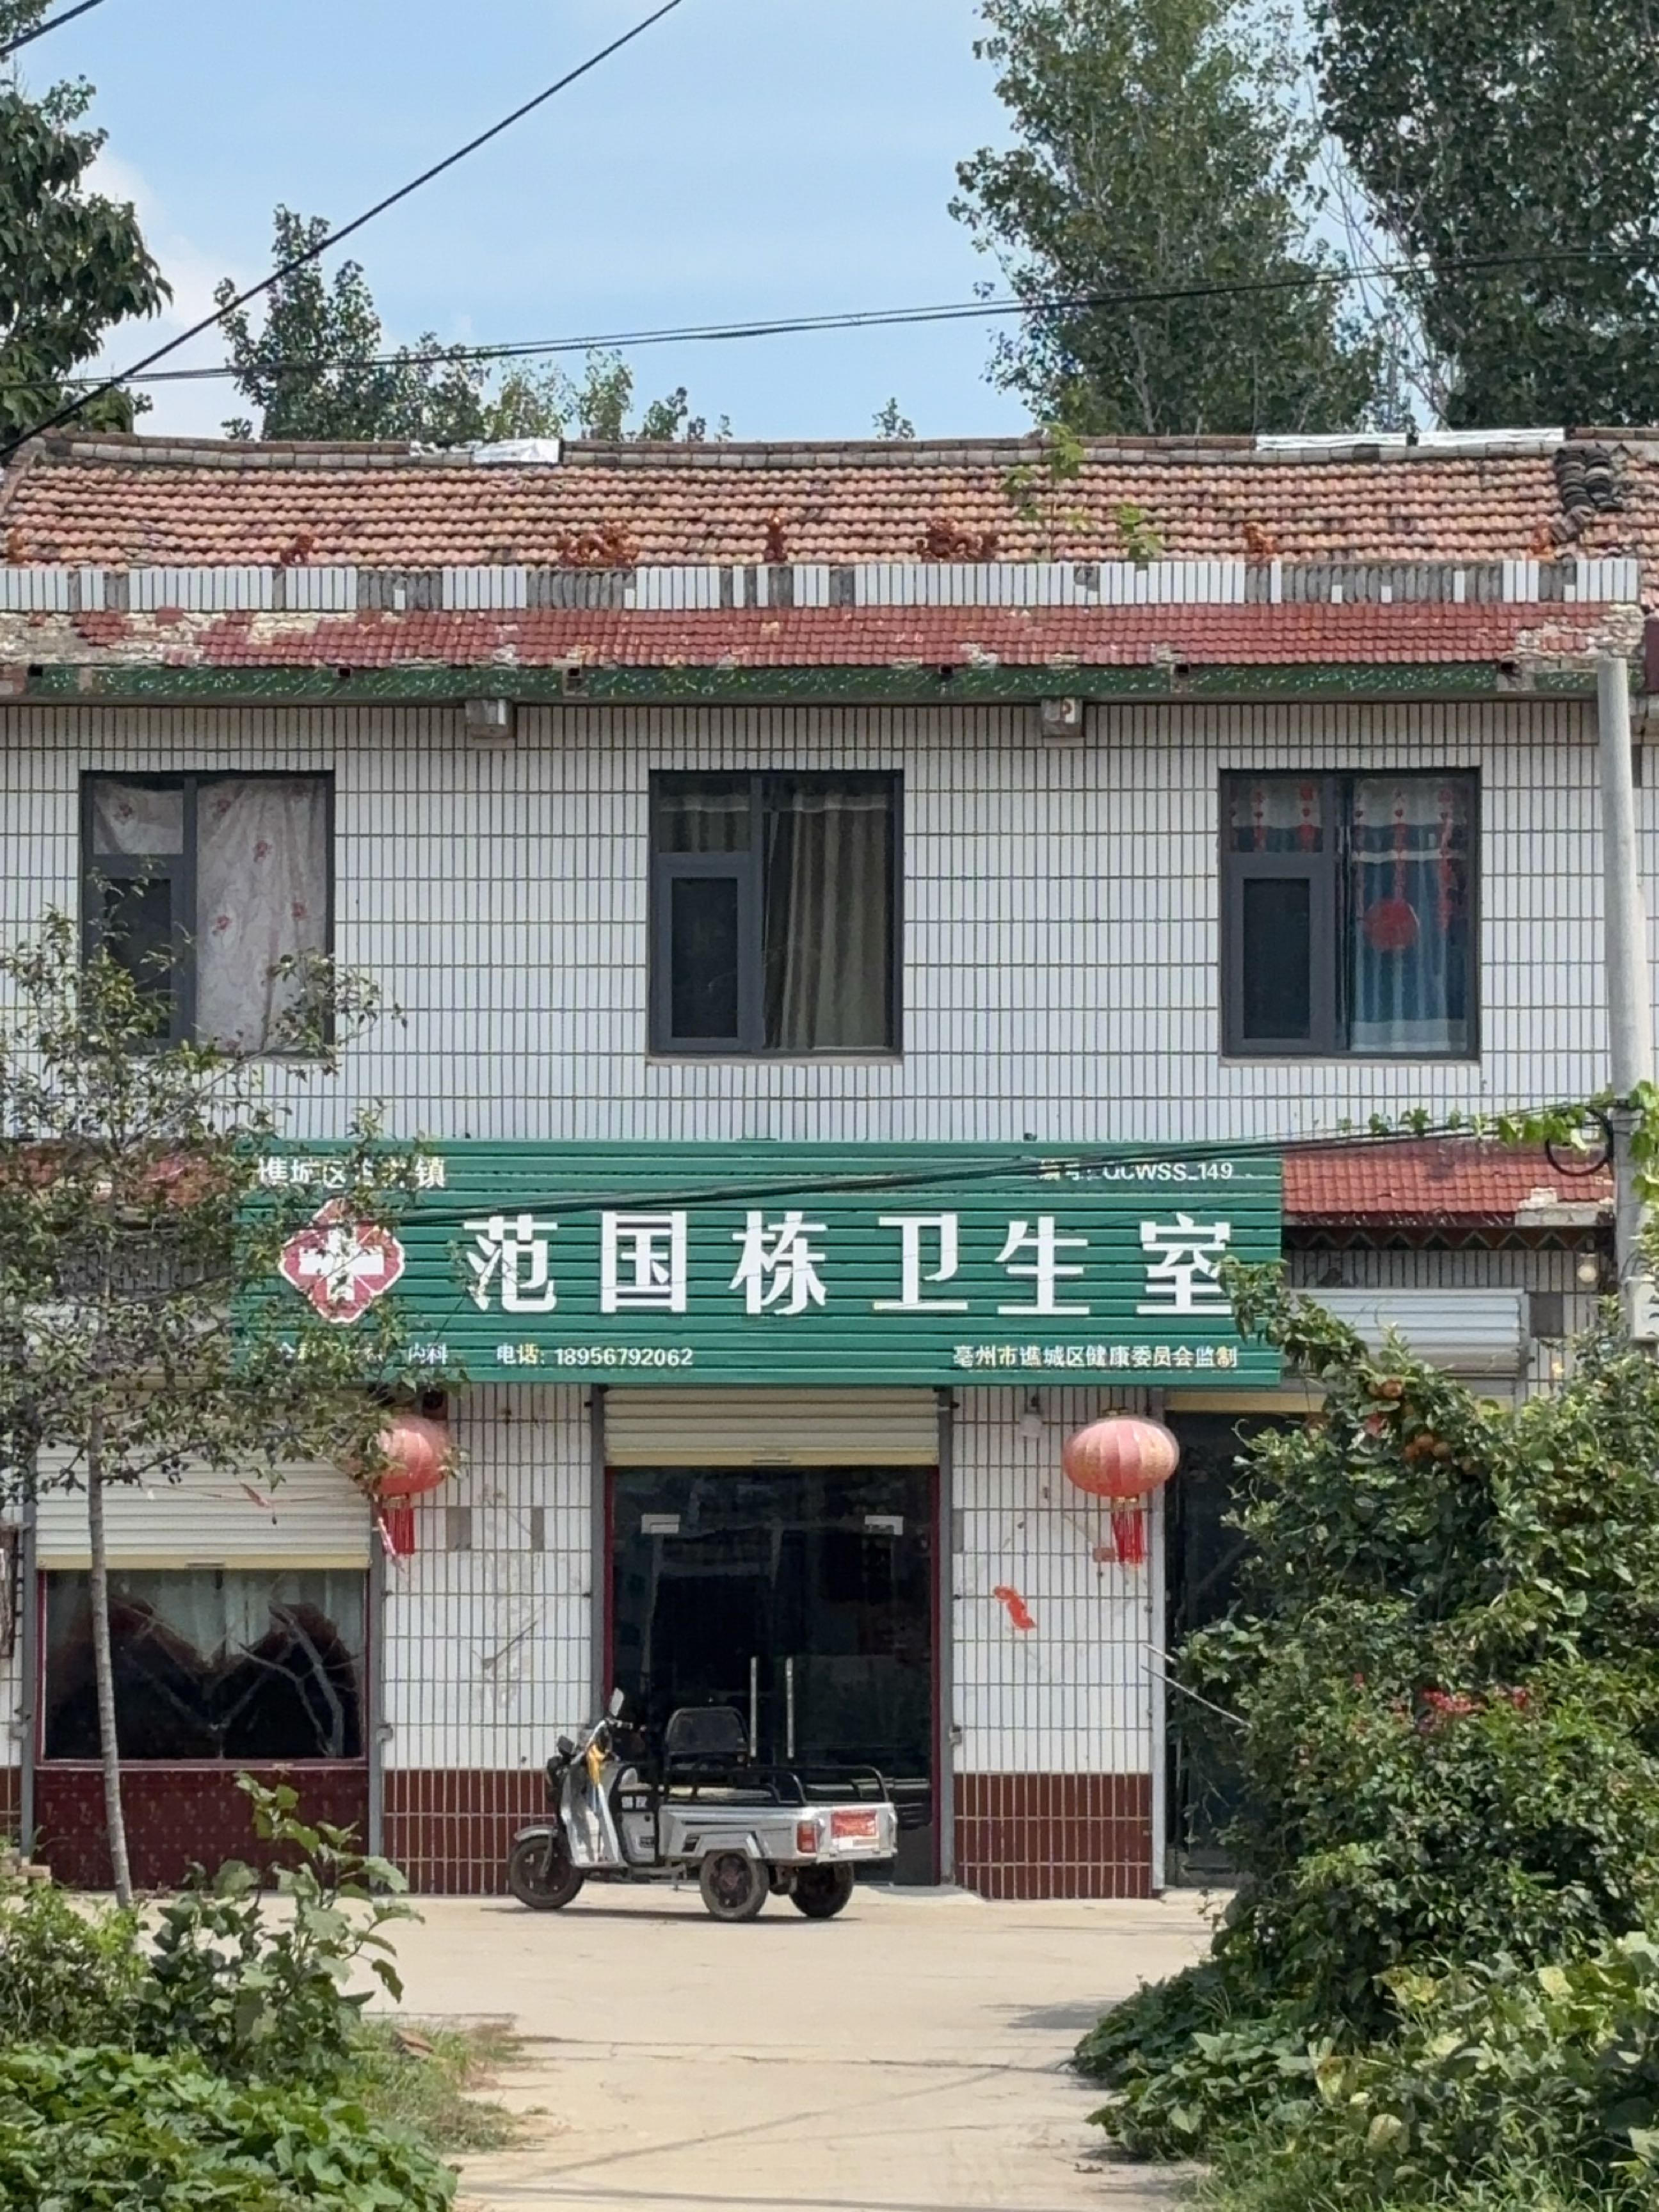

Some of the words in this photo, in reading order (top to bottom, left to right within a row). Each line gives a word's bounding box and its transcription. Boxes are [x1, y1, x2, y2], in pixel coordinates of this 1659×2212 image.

[463, 1210, 1233, 1316] 范国栋卫生室
[952, 1345, 1238, 1368] 亳州市谯城区健康委员会监制
